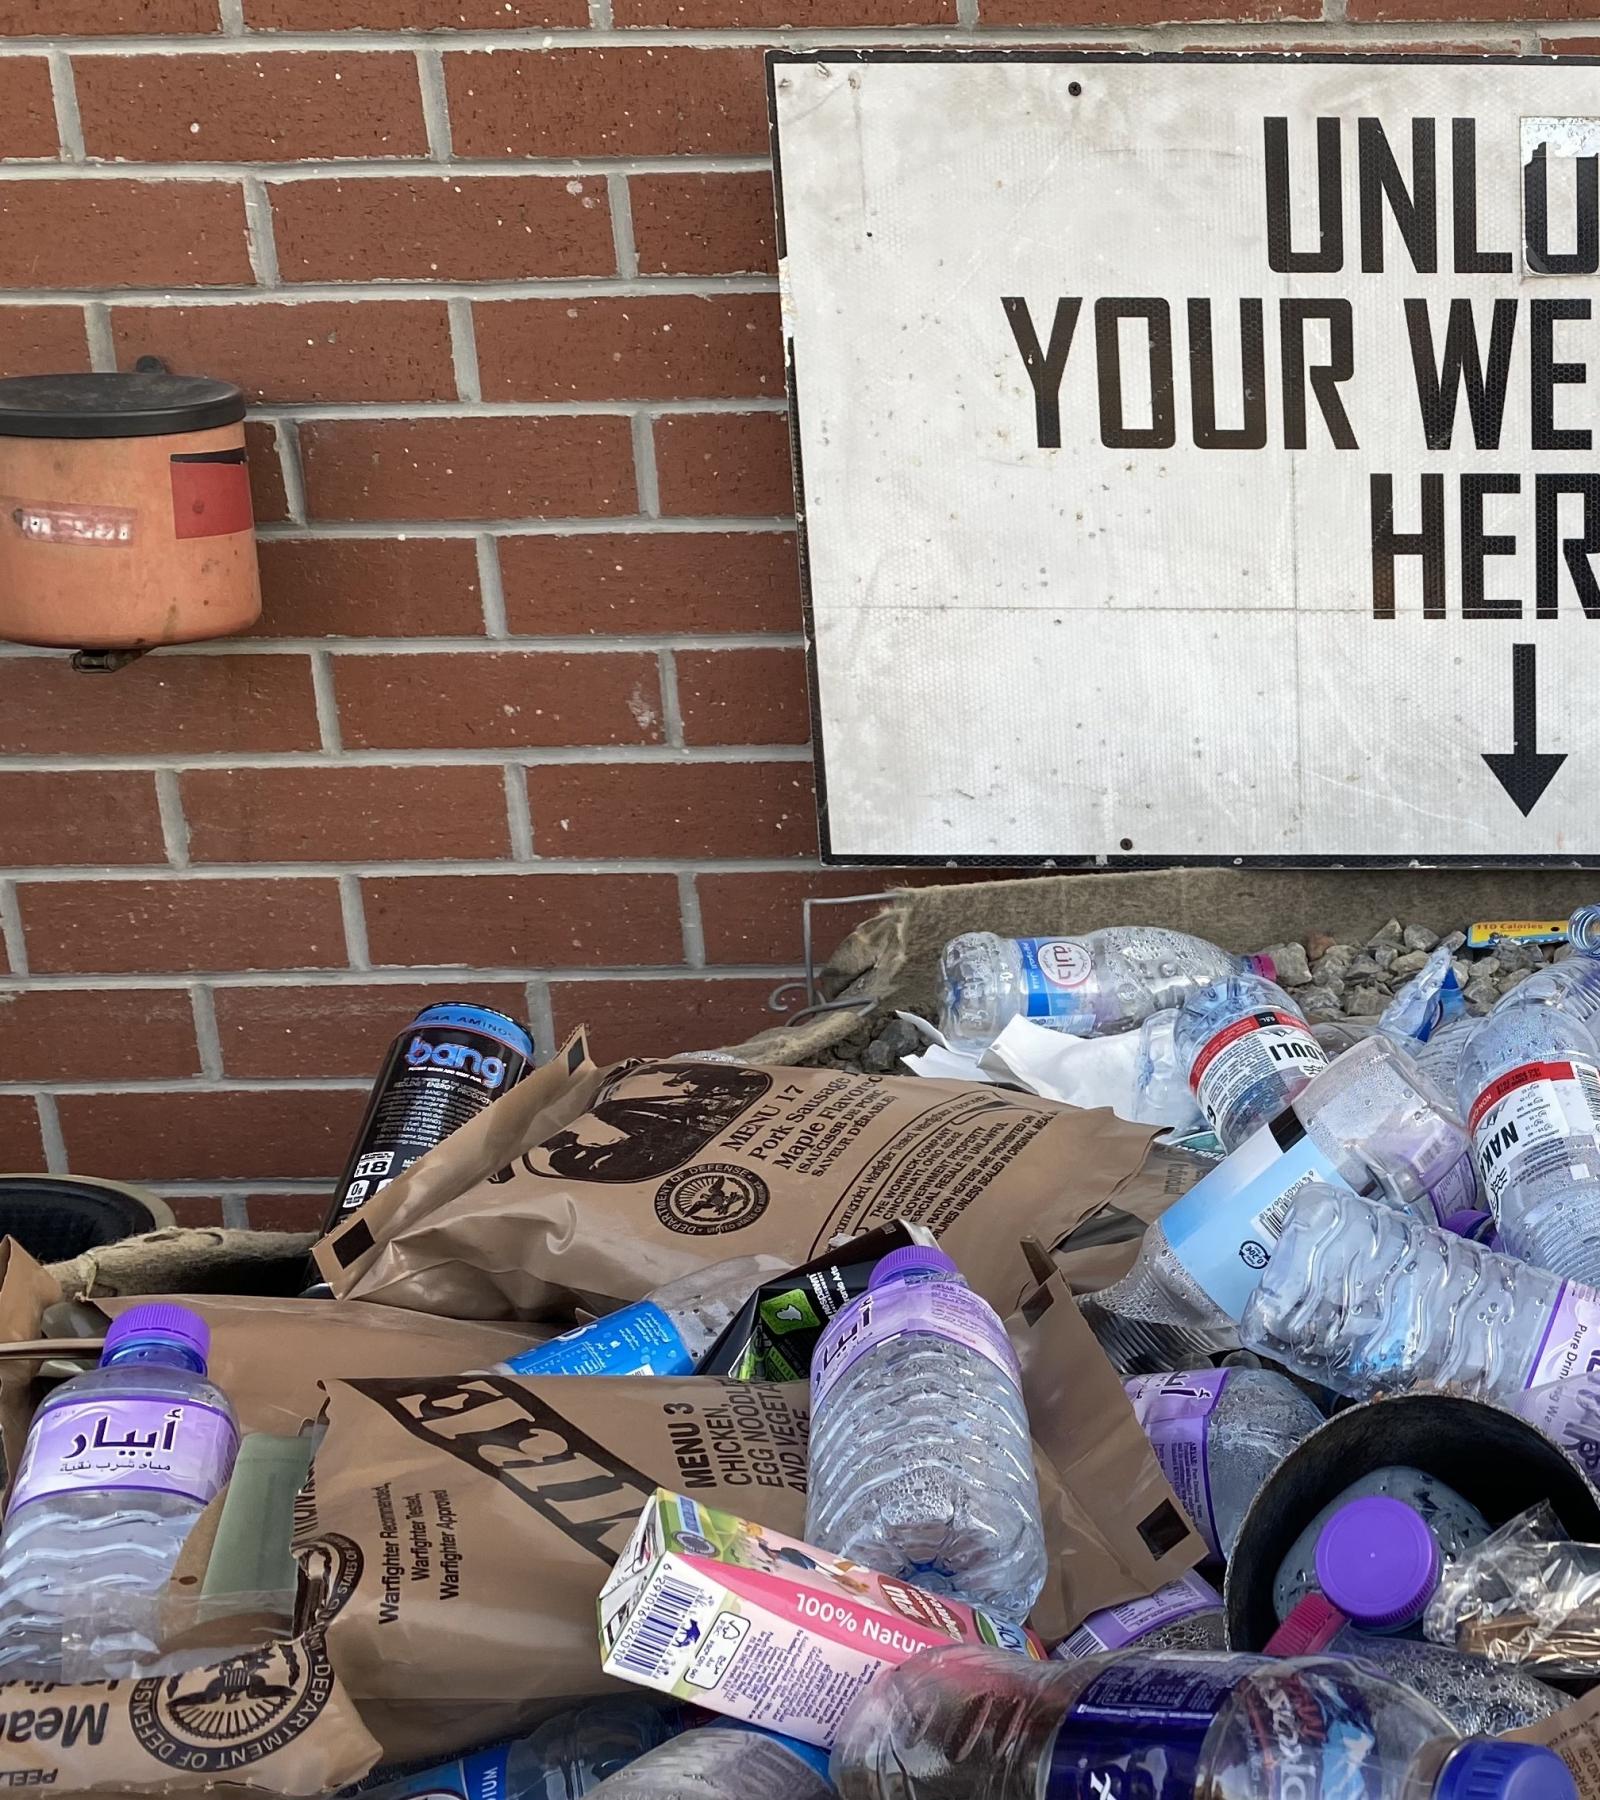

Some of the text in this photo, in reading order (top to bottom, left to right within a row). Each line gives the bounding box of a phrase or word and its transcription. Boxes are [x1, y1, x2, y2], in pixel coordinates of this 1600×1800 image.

[1002, 297, 1357, 449] YOUR
[1474, 922, 1544, 931] 110 Calories
[405, 1036, 505, 1089] bang
[427, 1082, 455, 1090] ENERGY
[719, 1083, 804, 1151] MENU 17
[747, 1075, 851, 1160] Pork Sausage
[772, 1122, 828, 1170] Maple
[796, 1106, 861, 1174] (SAUCISSE DE
[361, 1161, 388, 1174] 18
[811, 1134, 854, 1177] SAVEUR
[869, 1126, 951, 1217] THE WORNICK COMPANY
[881, 1164, 928, 1221] CINCINNATI,
[923, 1148, 943, 1166] OHIO
[900, 1125, 985, 1217] GOVERNMENT PROPERTY
[909, 1120, 1008, 1224] ERCIAL RESALE IS UNLAWFUL
[927, 1112, 1035, 1223] RATION HEATERS ARE PROHIBITED ON
[956, 1184, 982, 1210] UNLESS
[978, 1160, 1005, 1187] SEALED
[1001, 1153, 1012, 1163] IN
[1007, 1127, 1038, 1157] ORIGINAL
[830, 1265, 845, 1284] Arts
[1568, 1325, 1588, 1354] Pure
[62, 1407, 184, 1459] أبيار
[663, 1403, 717, 1488] MENU 3
[702, 1403, 752, 1485] CHICKEN,
[748, 1448, 784, 1488] EGG
[780, 1452, 807, 1494] AND
[370, 1481, 404, 1624] Warfighter Recommended,
[401, 1492, 432, 1581] Warfighter Tested,
[429, 1489, 462, 1600] Warfighter Approved
[612, 1563, 673, 1662] 6 291016 024010
[794, 1591, 858, 1633] 100%
[0, 1702, 109, 1748] Mea
[133, 1663, 332, 1769] DEPARTMENT OF DEFENSE
[0, 1767, 58, 1787] PEEL
